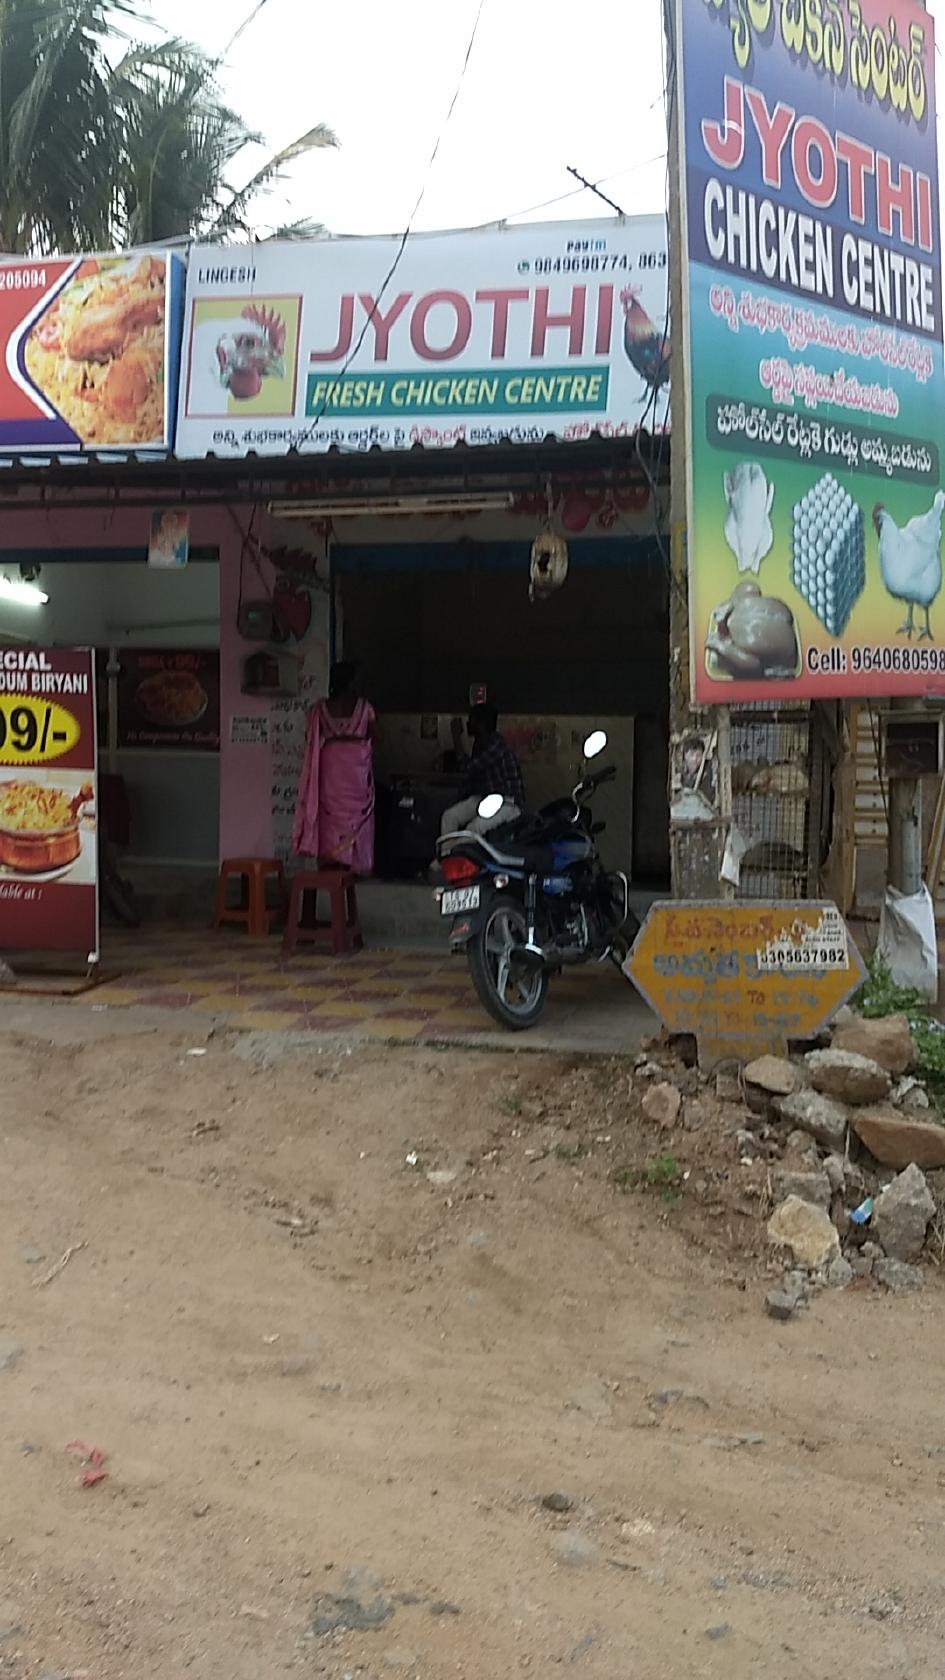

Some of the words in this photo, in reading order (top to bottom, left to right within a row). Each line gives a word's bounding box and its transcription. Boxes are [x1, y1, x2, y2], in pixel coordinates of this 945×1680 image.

[701, 74, 934, 254] JYOTHI
[198, 266, 257, 284] LINGESH
[704, 177, 834, 298] CHICKEN
[841, 232, 935, 333] CENTRE
[309, 283, 614, 362] JYOTHI
[312, 380, 384, 408] FRESH
[390, 377, 498, 406] CHICKEN
[504, 374, 603, 404] CENTRE
[807, 646, 846, 672] Cell:
[852, 646, 945, 673] 9640680598
[31, 672, 88, 694] BIRYANI
[0, 706, 67, 753] 9/-
